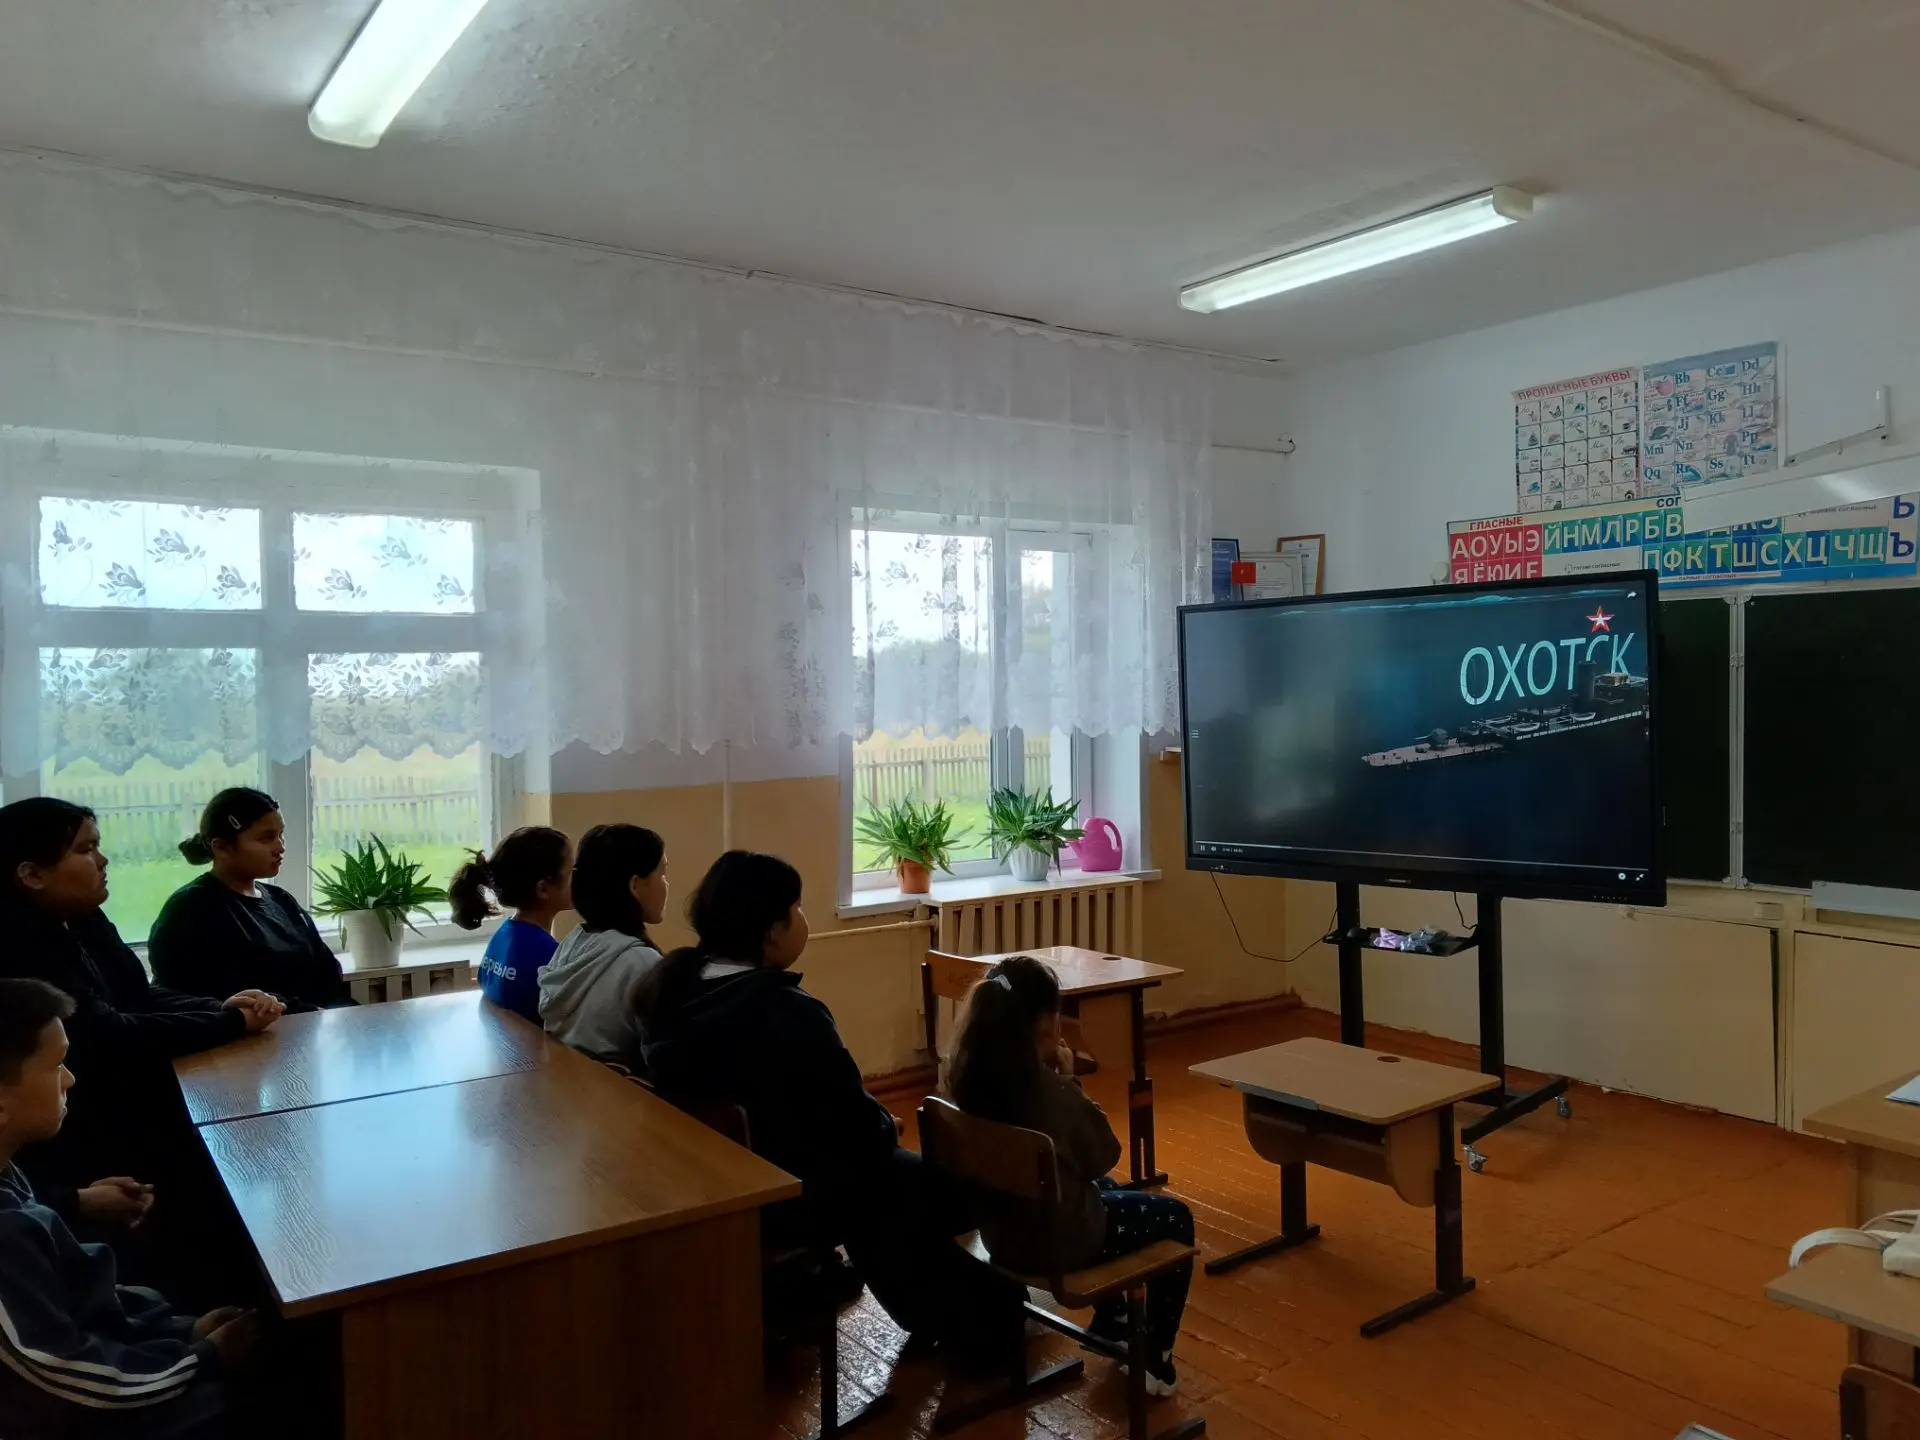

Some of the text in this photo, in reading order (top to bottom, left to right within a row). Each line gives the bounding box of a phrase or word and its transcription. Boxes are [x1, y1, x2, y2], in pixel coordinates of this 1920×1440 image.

[1675, 371, 1690, 384] Bb
[1742, 358, 1759, 372] Dd
[1518, 379, 1588, 400] ПРОПИСНЫЕ
[1591, 370, 1631, 385] БУКВЫ
[1707, 389, 1726, 401] Gg
[1644, 431, 1758, 456] Mm Nn Pp
[1644, 467, 1661, 480] Qq
[1709, 458, 1724, 469] Ss
[1656, 496, 1682, 508] СОГ
[1469, 516, 1524, 531] ГЛАСНЫЕ
[1460, 632, 1635, 705] ОХОТСК
[481, 956, 517, 980] ервые
